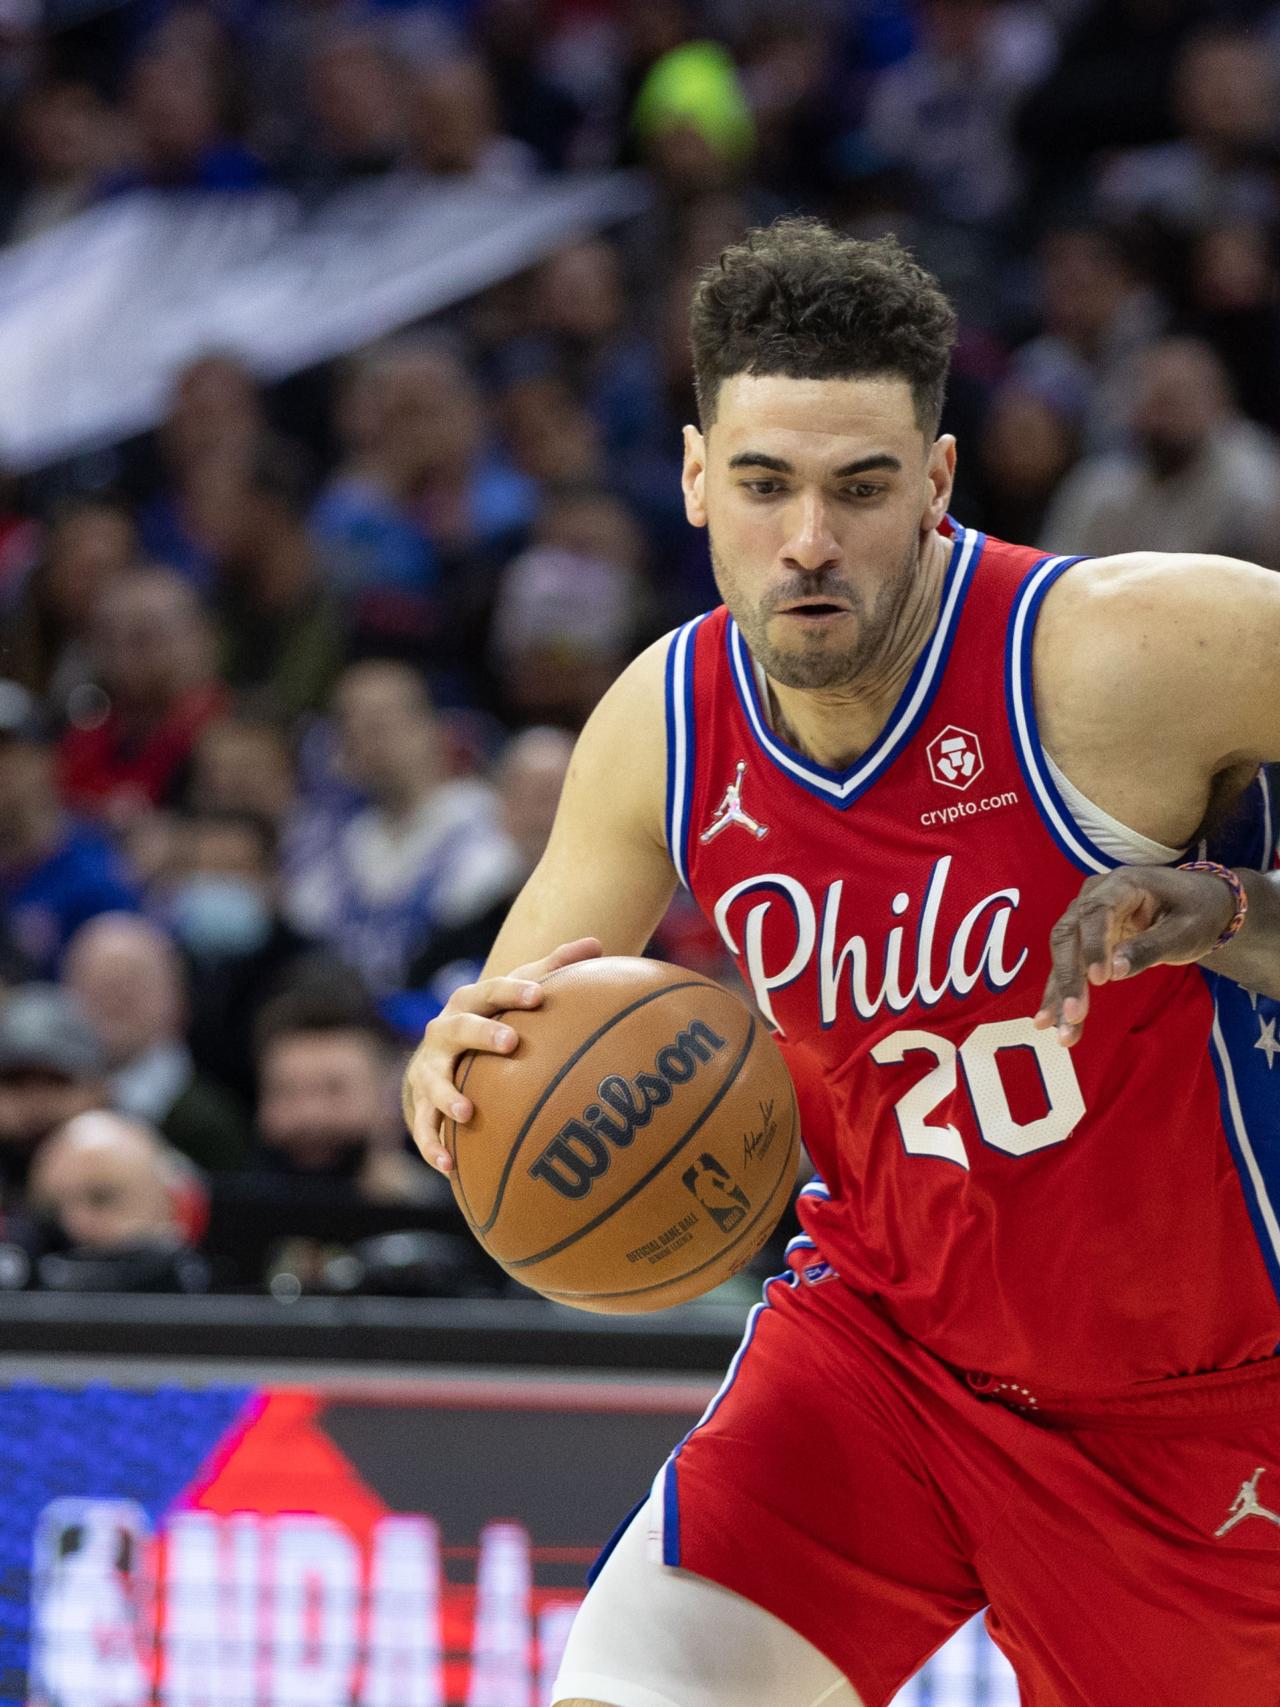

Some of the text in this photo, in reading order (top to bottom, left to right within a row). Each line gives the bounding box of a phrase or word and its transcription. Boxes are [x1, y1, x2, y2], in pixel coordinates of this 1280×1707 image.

[920, 790, 1018, 826] crypto.com
[713, 855, 1029, 1038] Phila
[527, 1019, 727, 1200] Wilson
[869, 1016, 1088, 1172] 20
